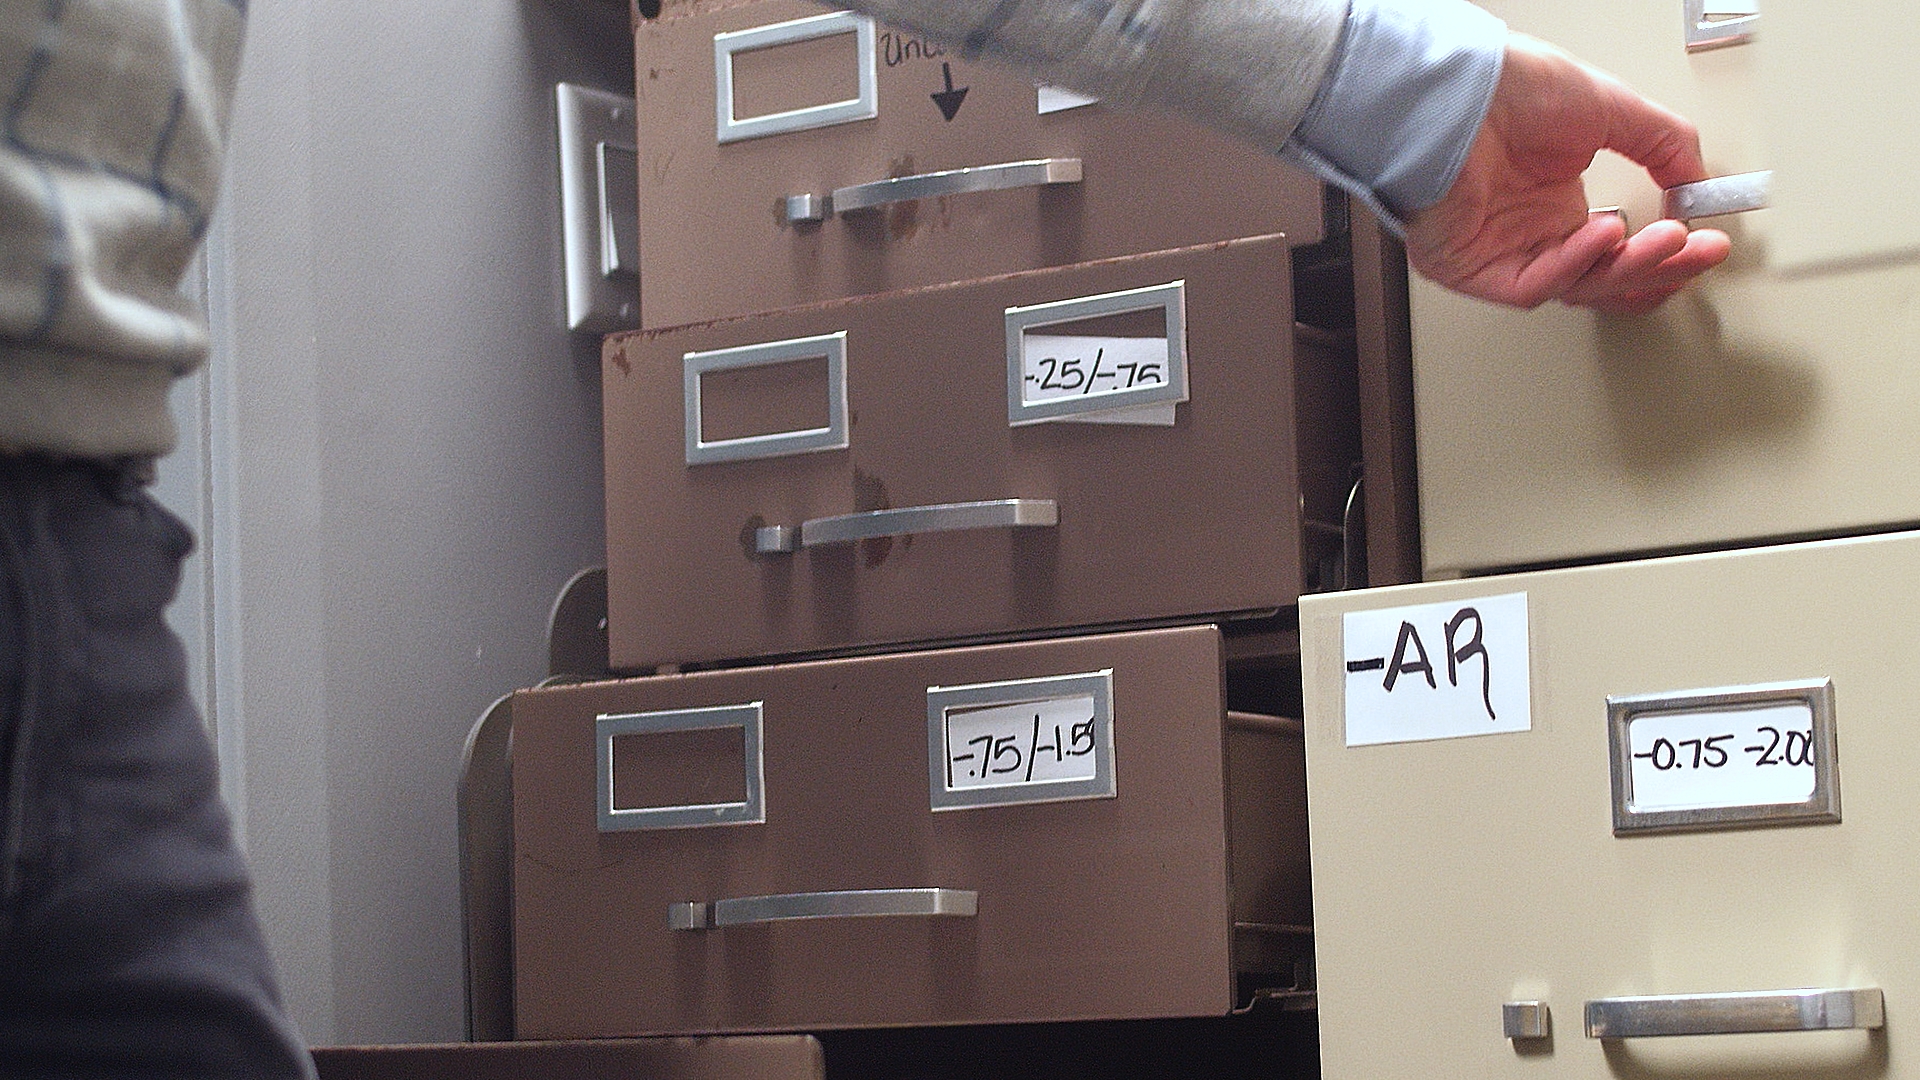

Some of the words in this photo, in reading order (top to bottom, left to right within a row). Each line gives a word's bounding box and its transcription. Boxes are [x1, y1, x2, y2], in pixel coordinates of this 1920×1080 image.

[1025, 347, 1161, 394] -.25/-.75
[1346, 607, 1496, 721] -AR
[1634, 734, 1734, 771] -0.75
